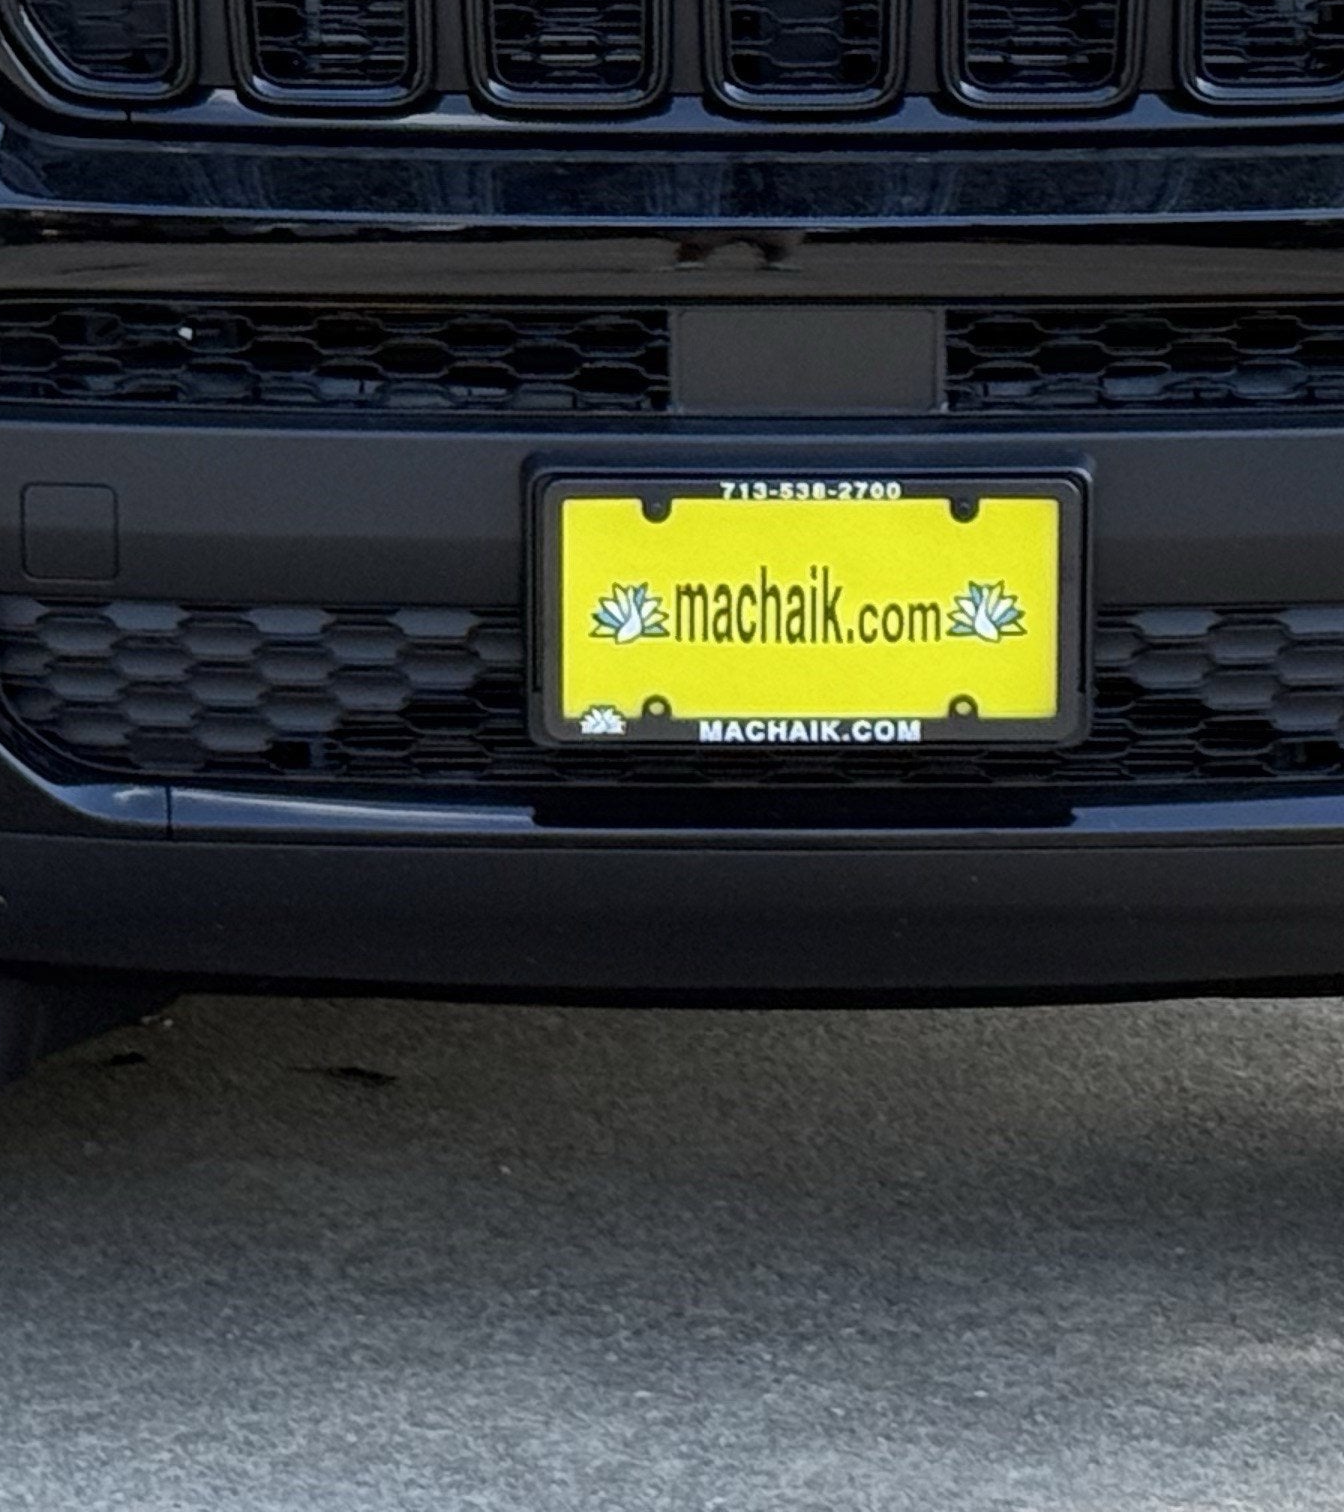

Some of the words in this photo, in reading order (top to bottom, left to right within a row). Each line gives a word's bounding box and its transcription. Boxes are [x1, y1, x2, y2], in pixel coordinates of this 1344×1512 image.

[719, 481, 902, 501] 713-538-2700
[674, 565, 942, 645] machaik.com
[699, 719, 922, 743] MACHAIK.COM
